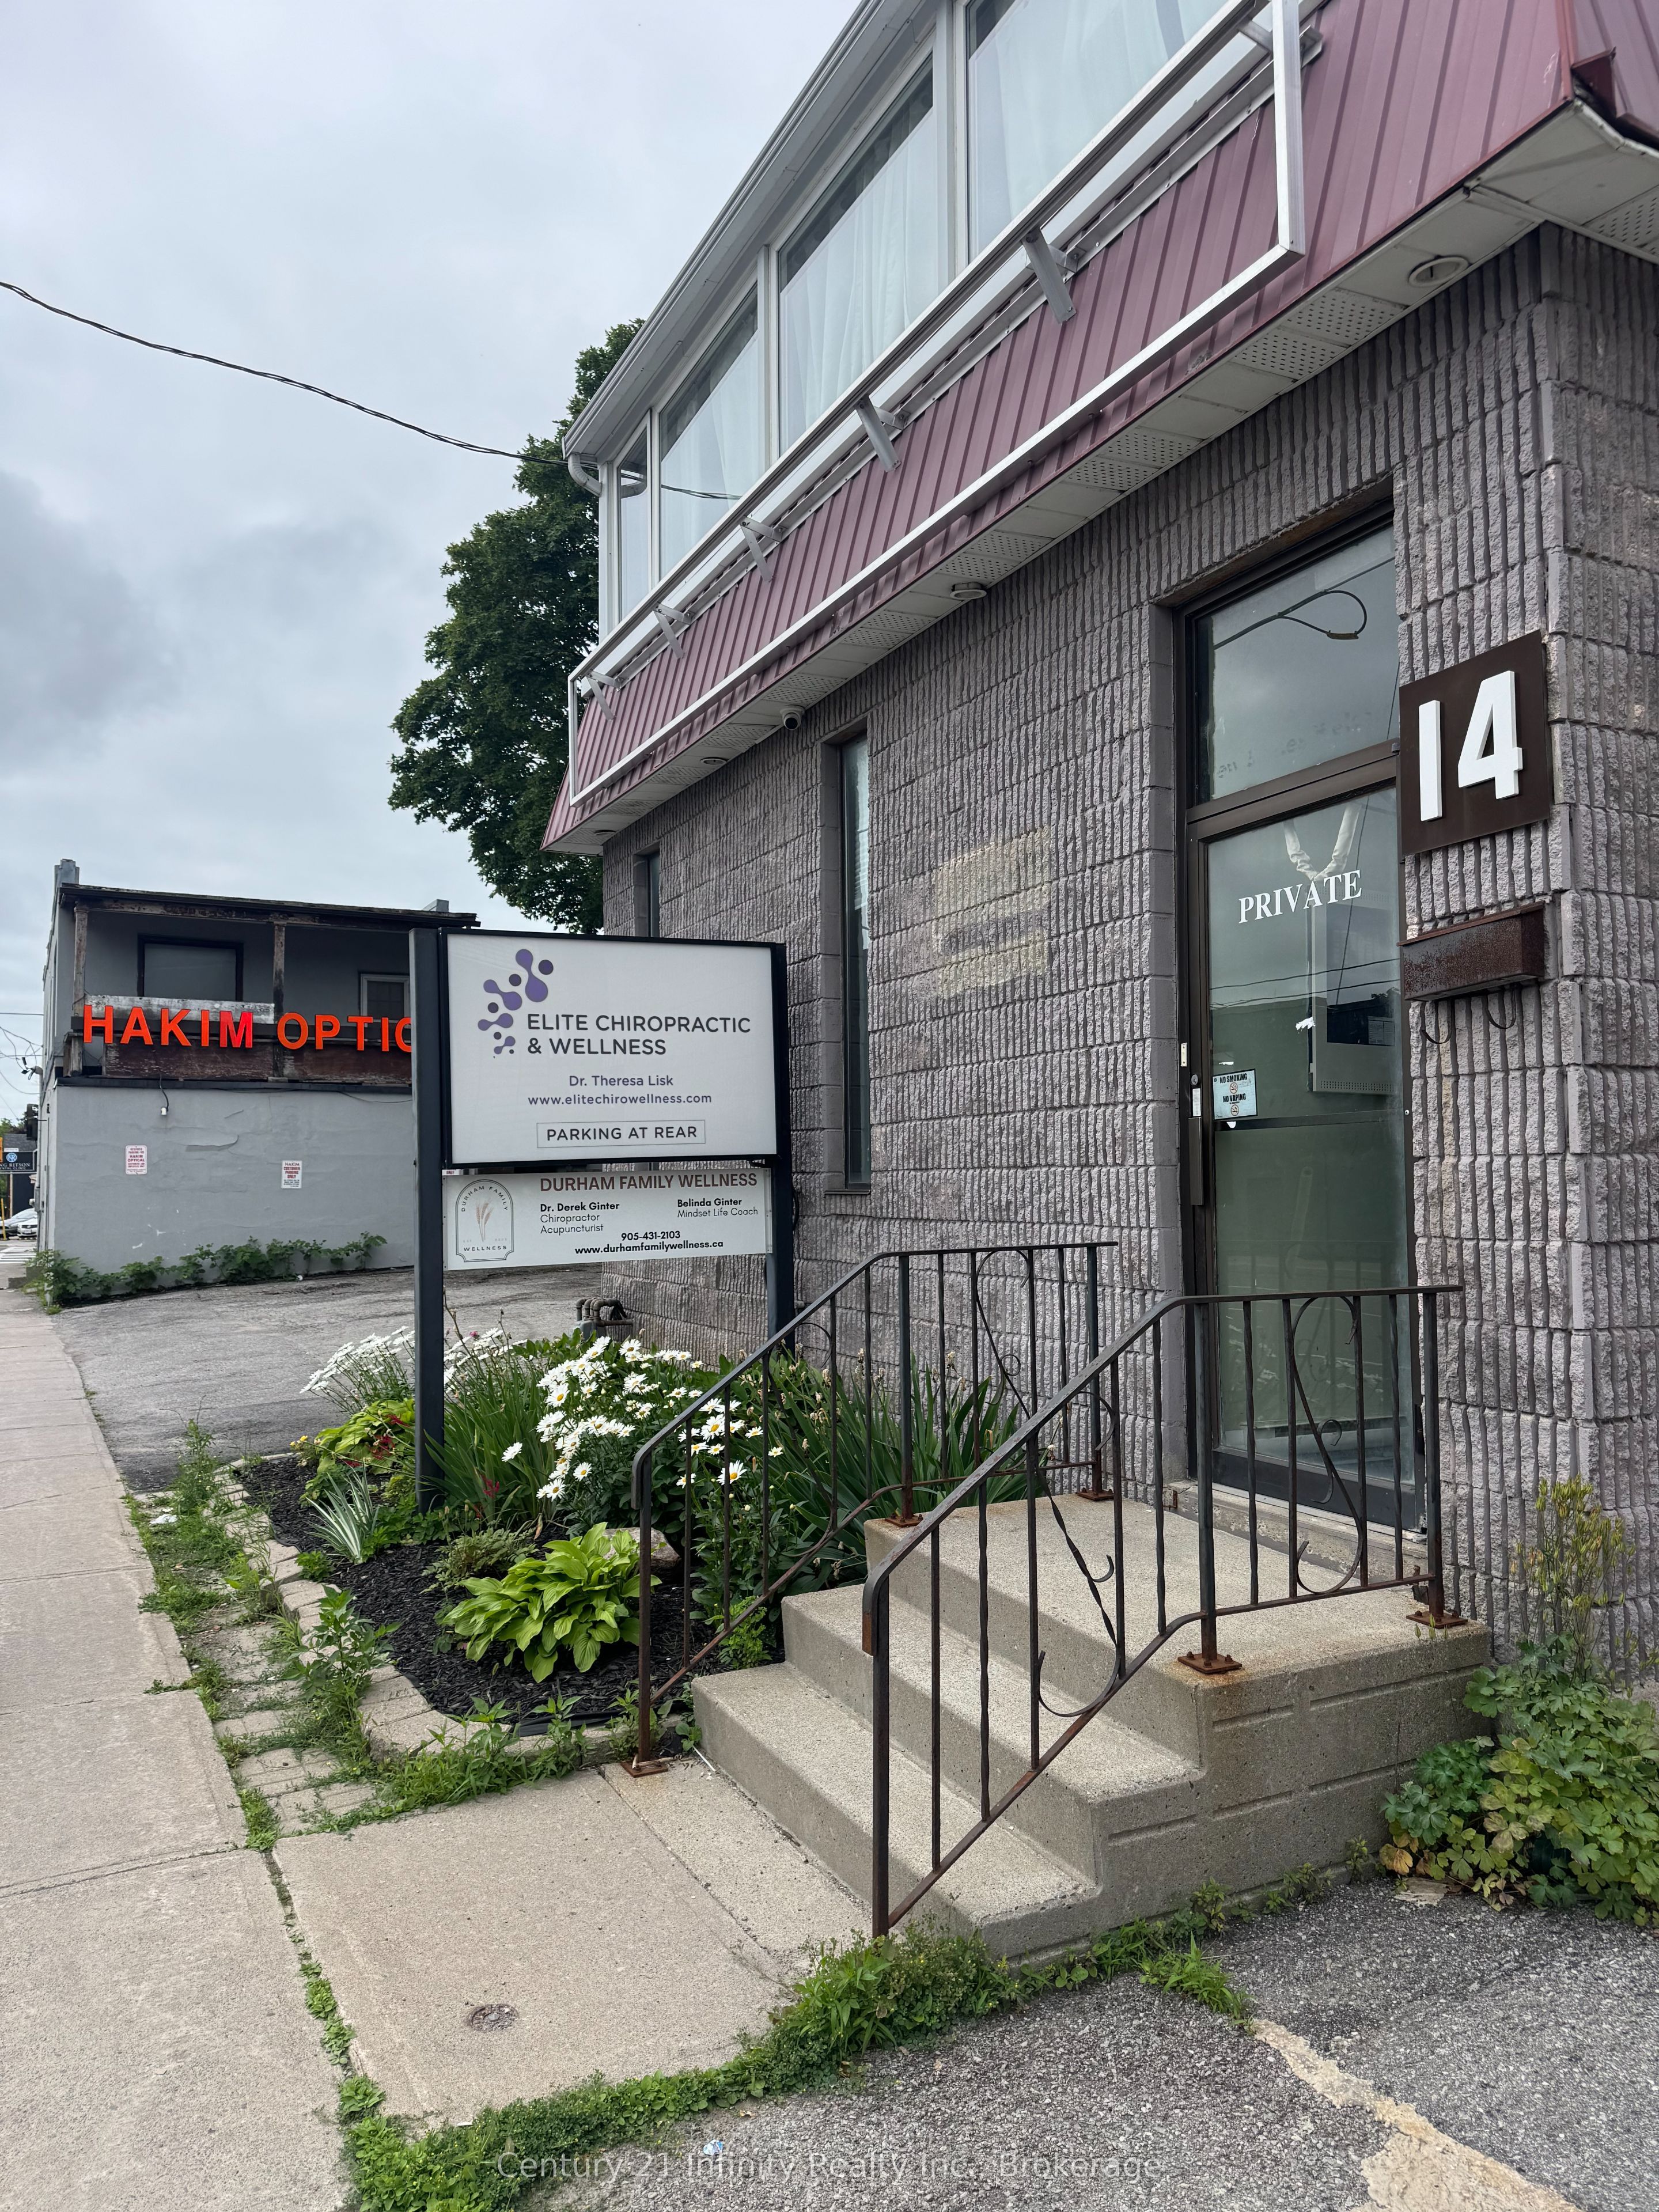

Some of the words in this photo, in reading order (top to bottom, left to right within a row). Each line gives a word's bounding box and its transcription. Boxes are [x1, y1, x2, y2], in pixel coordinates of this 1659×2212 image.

[1419, 670, 1523, 822] 14
[1238, 870, 1362, 923] PRIVATE
[83, 1005, 253, 1048] HAKIM
[528, 1014, 588, 1031] ELITE
[596, 1015, 751, 1033] CHIROPRACTIC
[528, 1037, 541, 1054] &
[549, 1038, 666, 1055] WELLNESS
[569, 1076, 587, 1086] Dr.
[592, 1075, 643, 1086] Theresa
[648, 1075, 673, 1086] Lisk
[1227, 1073, 1247, 1082] SMOKING
[528, 1094, 711, 1105] www.elitechirowellness.com
[1230, 1093, 1246, 1101] VAPING
[547, 1127, 622, 1141] PARKING
[628, 1127, 648, 1140] AT
[654, 1126, 697, 1139] REAR
[540, 1176, 615, 1192] DURHAM
[619, 1175, 674, 1190] FAMILY
[677, 1173, 757, 1188] WELLNESS
[461, 1185, 484, 1212] DURHAM
[488, 1186, 508, 1210] FAMILY
[677, 1199, 711, 1207] Belinda
[714, 1198, 742, 1207] Ginter
[540, 1203, 555, 1212] Dr.
[557, 1202, 586, 1211] Derek
[589, 1202, 620, 1211] Ginter
[677, 1209, 711, 1218] Mindset
[713, 1207, 728, 1217] Life
[730, 1207, 758, 1217] Coach
[540, 1213, 600, 1225] Chiropractor
[540, 1224, 604, 1236] Acupuncturist
[621, 1231, 680, 1241] 905-431-2103
[575, 1240, 724, 1255] www.durhamfamilywellness.ca
